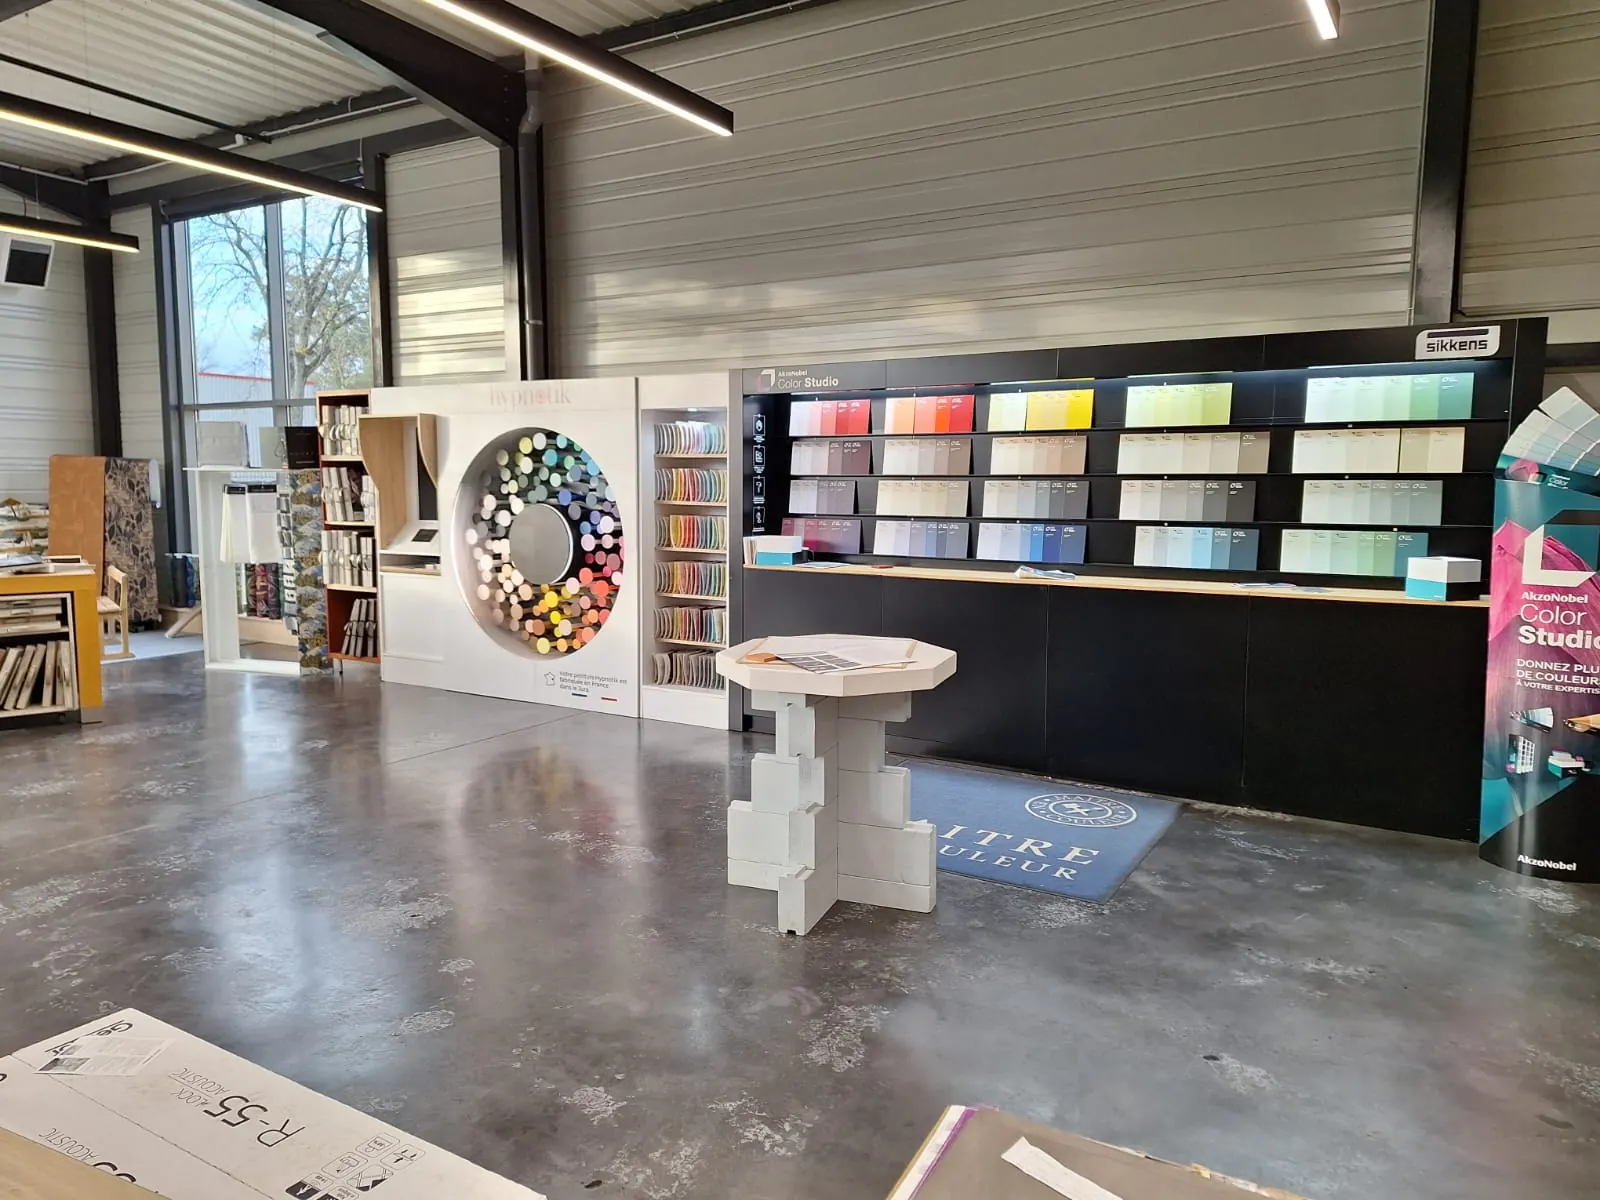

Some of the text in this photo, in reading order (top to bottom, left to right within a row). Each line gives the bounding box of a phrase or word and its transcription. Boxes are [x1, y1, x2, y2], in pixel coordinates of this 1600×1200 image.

[777, 376, 839, 390] Color Studio
[1521, 591, 1588, 604] AkzoNobel
[1520, 603, 1587, 625] Color
[1516, 658, 1600, 674] DONNEZ PLU
[1516, 669, 1600, 685] DE COULEUR
[1523, 681, 1553, 691] VOTRE
[1555, 685, 1600, 695] EXPERTIS
[937, 824, 1101, 865] ITRE
[938, 844, 1078, 880] ULEUR
[1517, 854, 1577, 871] AkzoNobel
[171, 1067, 230, 1095] ACOUSTIC
[202, 1095, 306, 1148] R-55
[38, 1127, 100, 1162] ACOUSTIC
